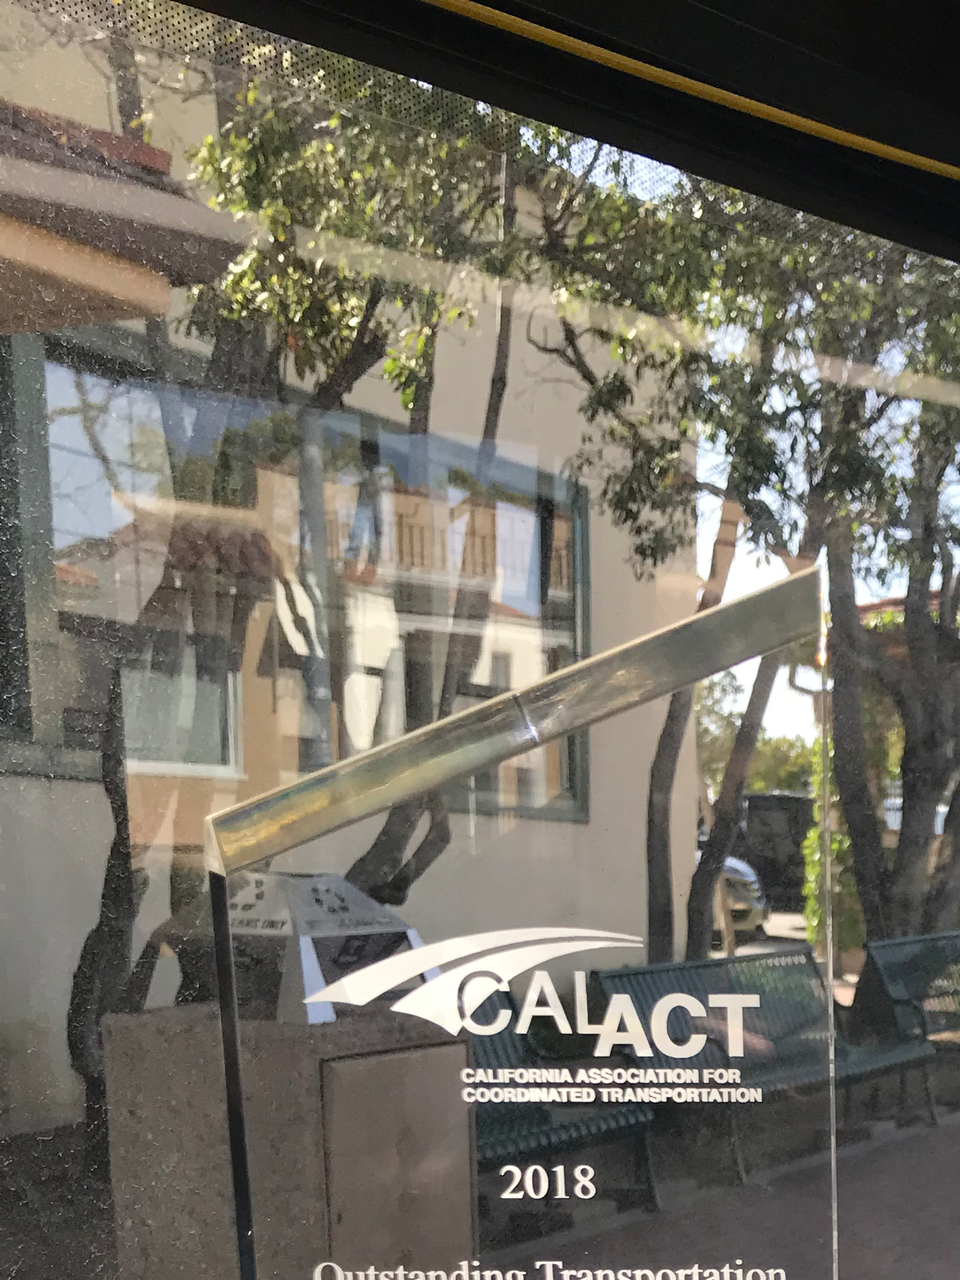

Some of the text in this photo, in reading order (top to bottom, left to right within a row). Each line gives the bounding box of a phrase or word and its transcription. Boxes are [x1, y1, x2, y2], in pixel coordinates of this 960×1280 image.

[460, 1068, 741, 1084] CALIFORNIA ASSOCIATION FOR
[461, 1087, 763, 1104] COORDINATED TRANSPORTATION
[499, 1165, 597, 1201] 2018
